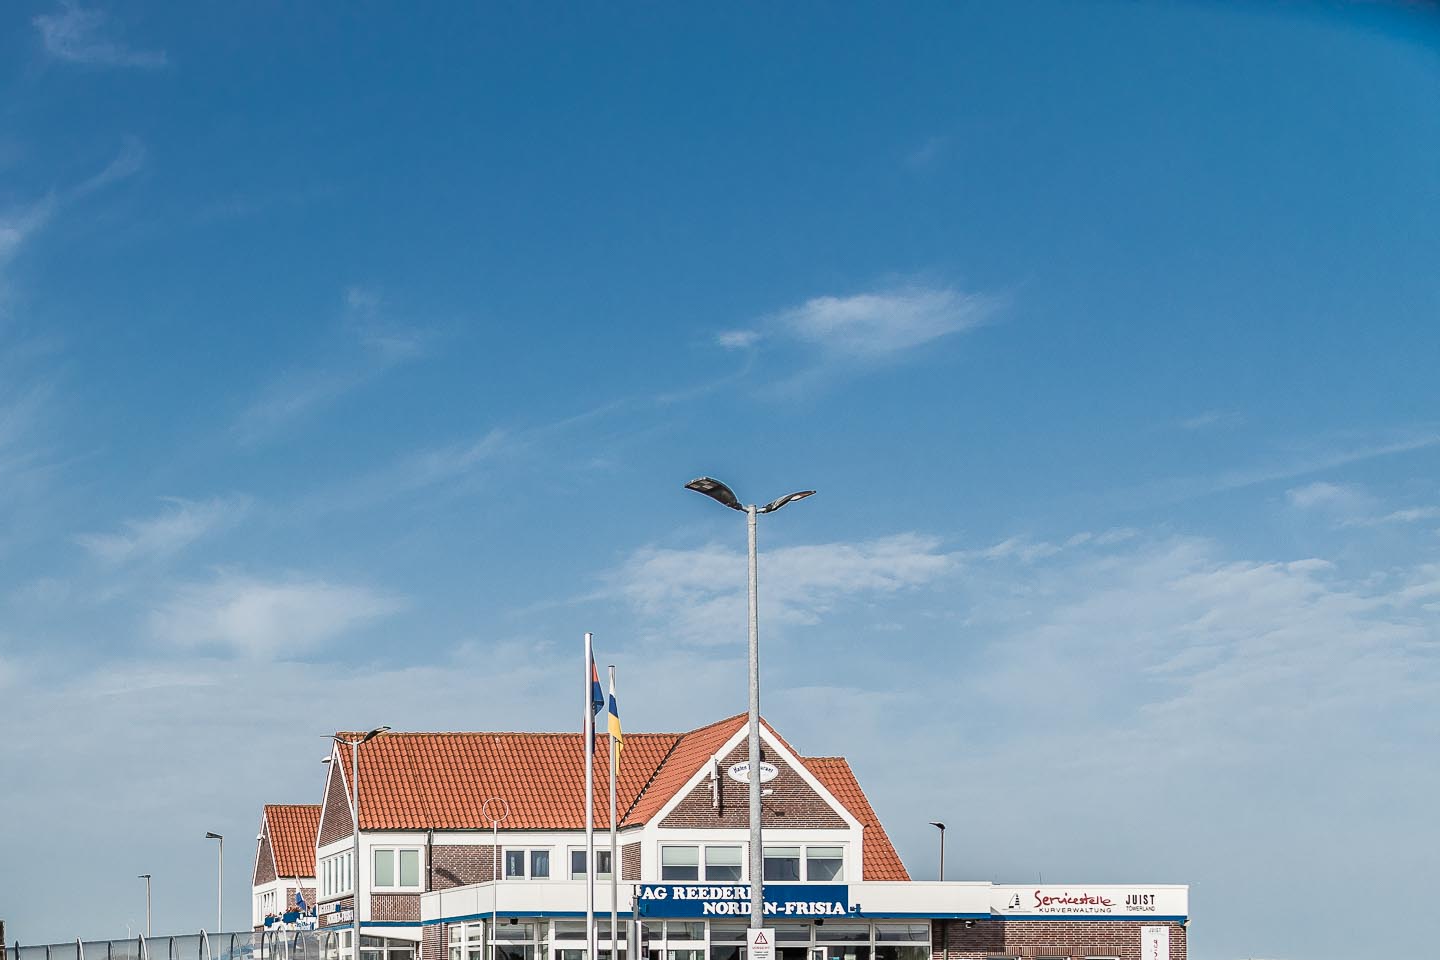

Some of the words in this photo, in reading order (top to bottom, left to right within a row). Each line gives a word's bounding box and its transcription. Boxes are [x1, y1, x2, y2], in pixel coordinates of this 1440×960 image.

[641, 886, 668, 900] AG
[672, 886, 766, 900] REEDER
[1033, 889, 1117, 908] Servicestelle
[1125, 894, 1156, 905] JUIST
[702, 901, 847, 915] NORDN-FRISIA
